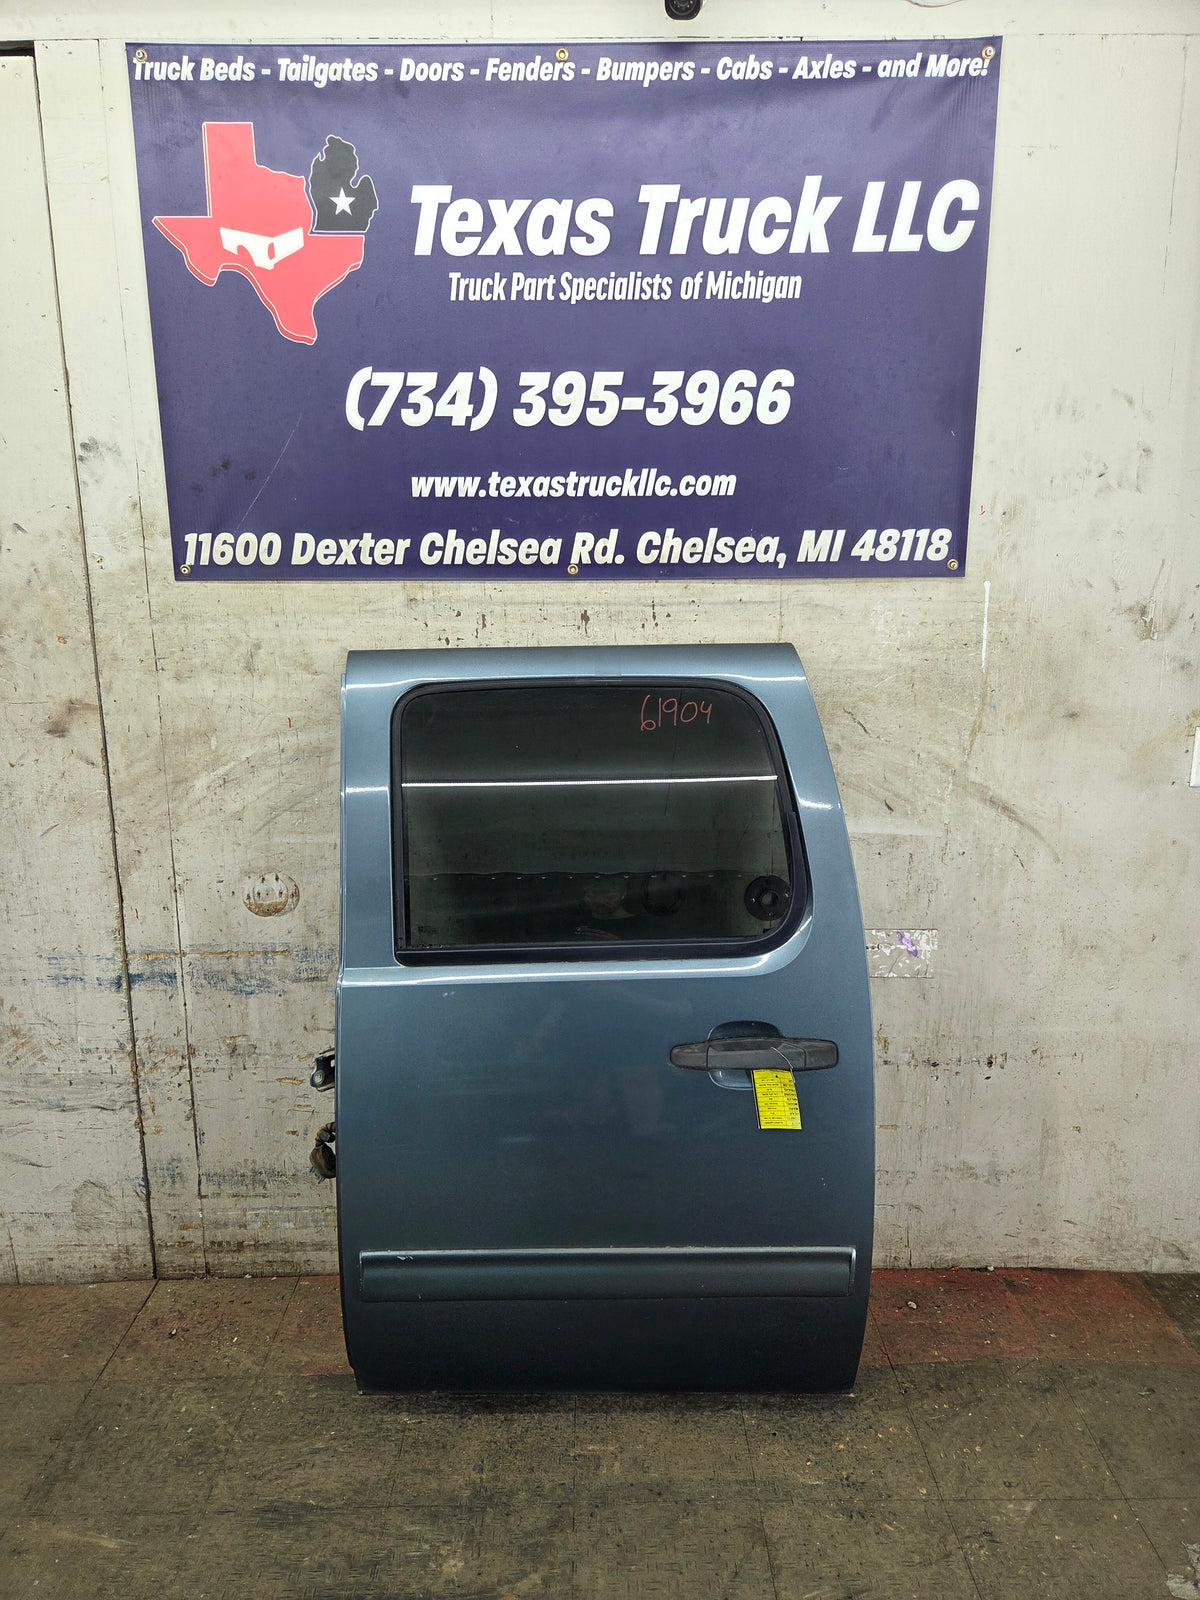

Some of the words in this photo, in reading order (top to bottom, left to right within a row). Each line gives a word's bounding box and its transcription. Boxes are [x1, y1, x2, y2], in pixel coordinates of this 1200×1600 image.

[133, 55, 194, 81] Truck
[200, 58, 256, 82] Beds
[278, 54, 379, 88] Tailgates
[399, 58, 465, 82] Doors
[485, 55, 577, 82] Fenders
[596, 56, 696, 88] Bumpers
[716, 54, 774, 81] Cabs
[792, 53, 857, 80] Axles
[877, 52, 922, 78] and
[925, 51, 989, 77] More!
[410, 184, 614, 257] Texas
[637, 174, 843, 256] Truck
[851, 178, 980, 254] LLC
[448, 271, 506, 302] Truck
[510, 271, 557, 302] Part
[558, 270, 673, 306] Specialists
[679, 270, 704, 301] of
[704, 269, 803, 304] Michigan
[345, 365, 498, 432] (734)
[512, 368, 795, 428] 395-3966
[411, 467, 737, 499] www.texastruckllc.com
[181, 532, 282, 571] 11600
[290, 532, 411, 567] Dexter
[419, 528, 563, 567] Chelsea
[570, 527, 625, 567] Rd.
[636, 526, 787, 569] Chelsea,
[796, 529, 847, 564] MI
[850, 527, 953, 562] 48118
[640, 694, 713, 732] 61904
